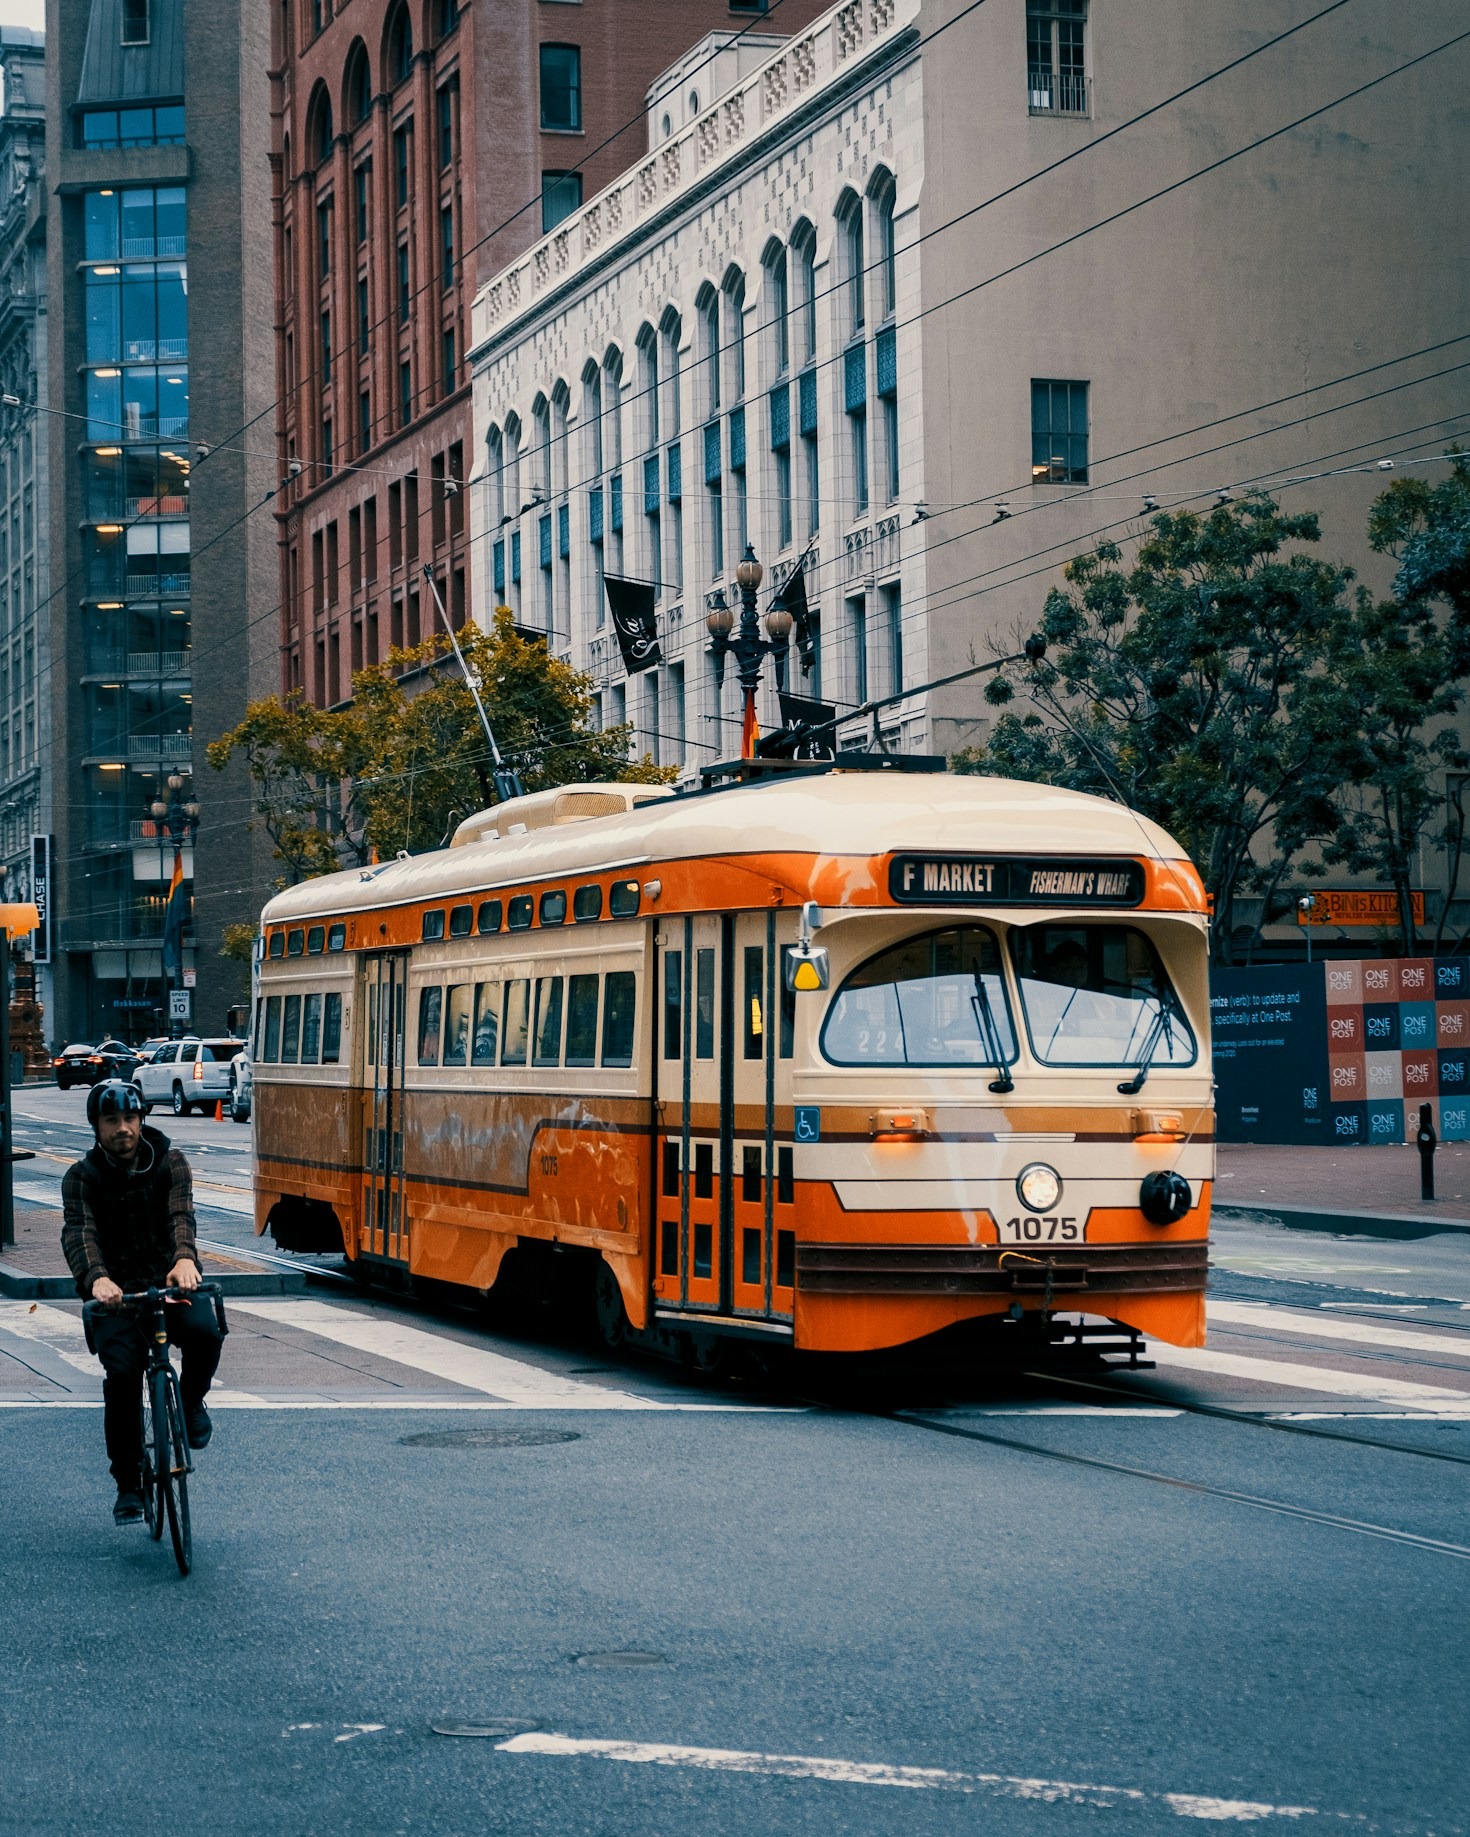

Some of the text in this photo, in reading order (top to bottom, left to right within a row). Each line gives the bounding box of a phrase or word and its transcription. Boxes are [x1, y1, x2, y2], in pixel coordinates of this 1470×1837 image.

[904, 863, 995, 892] F MARKET
[1030, 871, 1132, 896] FISHERMAN'S WHARF
[36, 877, 45, 921] CHASE
[1369, 894, 1421, 912] KITCN
[1329, 971, 1352, 981] ONE
[1365, 970, 1388, 980] ONE
[1402, 968, 1424, 978] ONE
[1438, 967, 1460, 977] ONE
[1330, 982, 1352, 990] POST
[1366, 980, 1388, 988] POST
[1402, 979, 1424, 987] POST
[1438, 977, 1460, 986] POST
[1252, 995, 1260, 1005] to
[1262, 992, 1285, 1006] update
[1287, 991, 1300, 1003] and
[174, 1004, 186, 1012] 10
[1215, 1012, 1250, 1025] specifically
[1252, 1013, 1258, 1023] at
[1260, 1011, 1274, 1022] One
[1368, 1018, 1390, 1028] ONE
[1404, 1016, 1426, 1026] ONE
[1440, 1015, 1462, 1025] ONE
[1331, 1019, 1354, 1030] ONE
[1440, 1025, 1462, 1034] POST
[1332, 1030, 1355, 1038] POST
[1368, 1028, 1390, 1036] POST
[1404, 1026, 1426, 1034] POST
[1370, 1066, 1392, 1076] ONE
[1406, 1064, 1428, 1074] ONE
[1442, 1062, 1464, 1073] ONE
[1333, 1068, 1356, 1078] ONE
[1442, 1073, 1464, 1082] POST
[1334, 1078, 1356, 1087] POST
[1370, 1076, 1392, 1085] POST
[1406, 1074, 1429, 1083] POST
[1303, 1088, 1318, 1099] ONE
[1304, 1100, 1318, 1108] POST
[1372, 1114, 1395, 1124] ONE
[1444, 1110, 1466, 1121] ONE
[1336, 1116, 1359, 1126] ONE
[1444, 1121, 1466, 1130] POST
[1336, 1126, 1358, 1134] POST
[1372, 1124, 1395, 1133] POST
[1006, 1217, 1078, 1241] 1075
